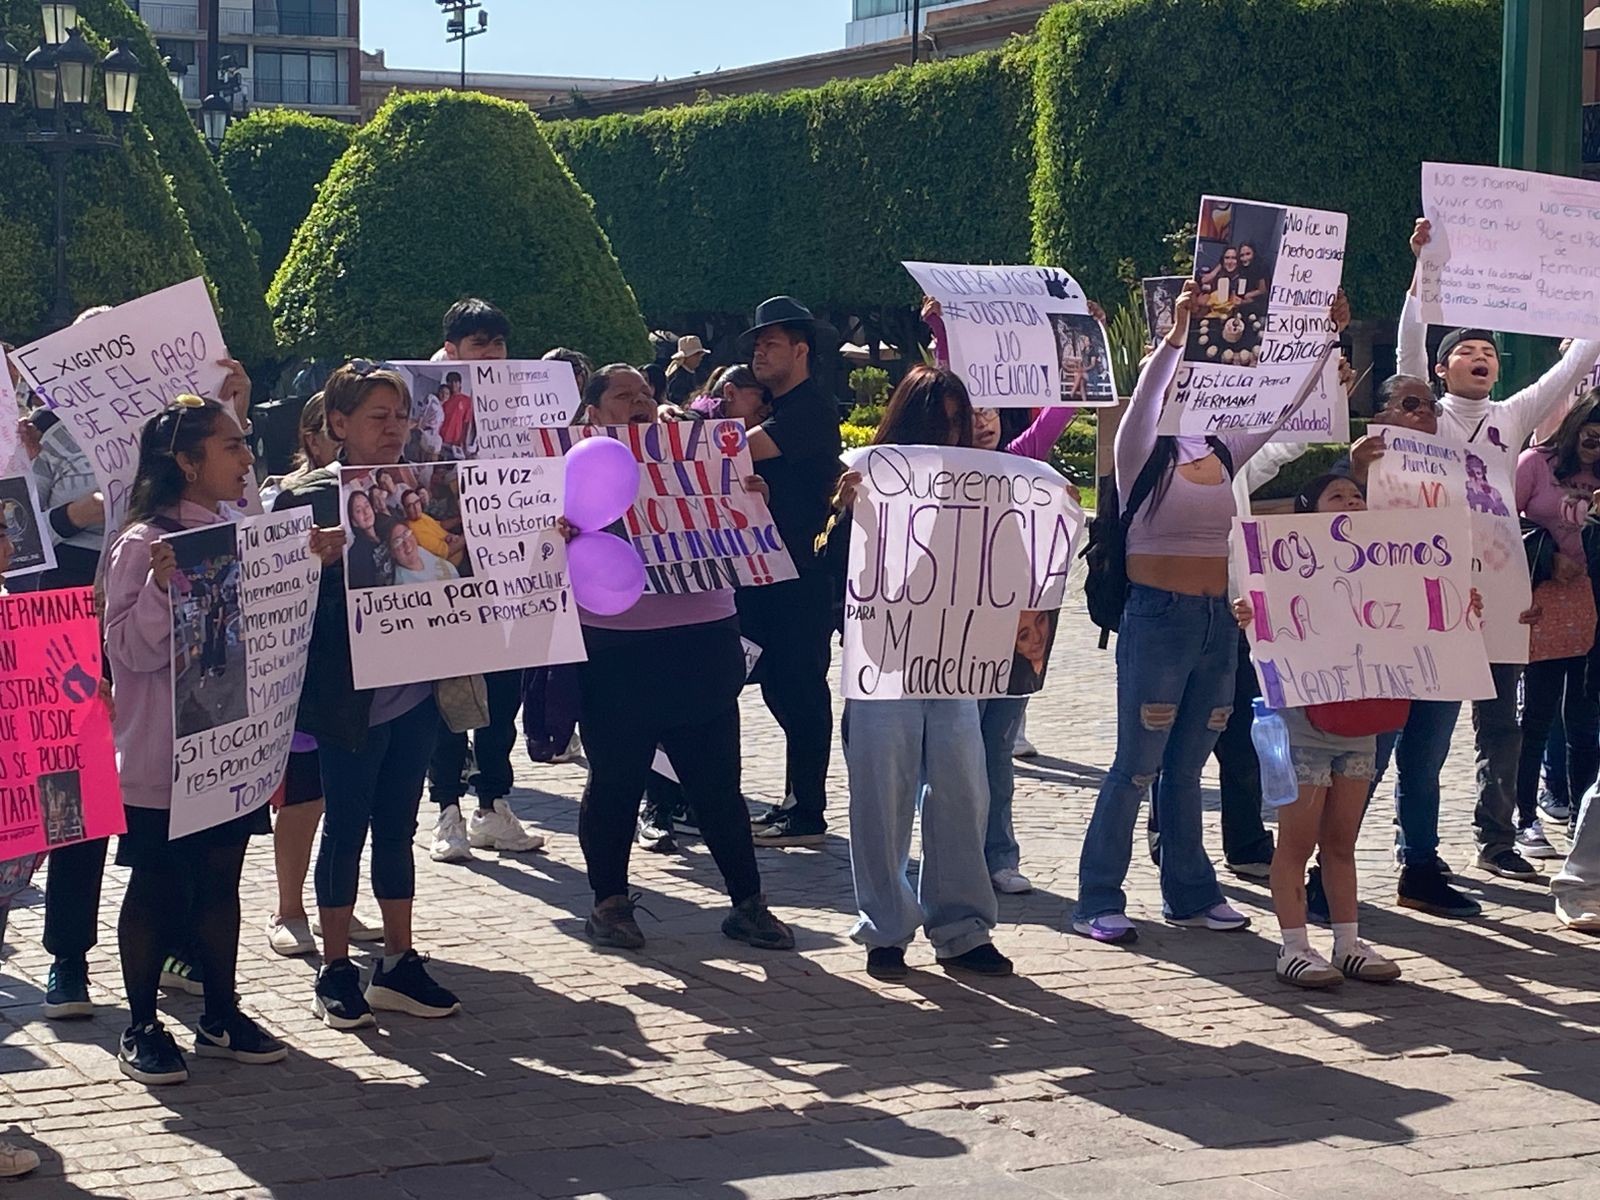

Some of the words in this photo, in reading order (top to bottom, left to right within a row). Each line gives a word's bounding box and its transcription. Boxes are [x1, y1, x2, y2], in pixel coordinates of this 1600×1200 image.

[1483, 175, 1529, 193] normal
[1476, 197, 1502, 210] con
[1325, 223, 1339, 238] un
[1480, 217, 1498, 230] en
[1504, 218, 1521, 231] tu
[1281, 237, 1315, 260] hecho
[930, 268, 1045, 296] QUEREMOS
[1290, 265, 1313, 284] fue
[943, 301, 1044, 327] #JUSTICIA
[1266, 312, 1338, 340] Exigimos
[105, 363, 151, 391] EL
[151, 331, 207, 376] CASO
[968, 362, 1051, 398] SILENCIO!
[1177, 366, 1254, 390] Justicia
[73, 411, 112, 440] SE
[109, 370, 211, 425] REVISE
[477, 395, 499, 413] No
[505, 394, 529, 409] era
[533, 391, 560, 407] un
[1192, 393, 1257, 409] HERMANA
[540, 410, 567, 426] era
[479, 434, 512, 450] una
[868, 446, 1052, 506] Queremos
[465, 493, 502, 514] nos
[626, 497, 669, 536] NO
[466, 519, 492, 538] tu
[496, 513, 557, 537] historia
[848, 502, 1071, 609] JUSTICIA
[1241, 520, 1325, 578] Hoy
[1330, 514, 1452, 574] Somos
[305, 567, 320, 585] tu
[443, 578, 499, 609] para
[1333, 576, 1406, 630] Voz
[245, 599, 308, 633] memoria
[428, 607, 472, 628] más
[847, 603, 877, 621] PARA
[858, 608, 1010, 696] Madeline
[29, 709, 79, 742] DESDE
[210, 720, 269, 756] tocan
[13, 752, 31, 779] SE
[37, 743, 86, 772] PUEDE
